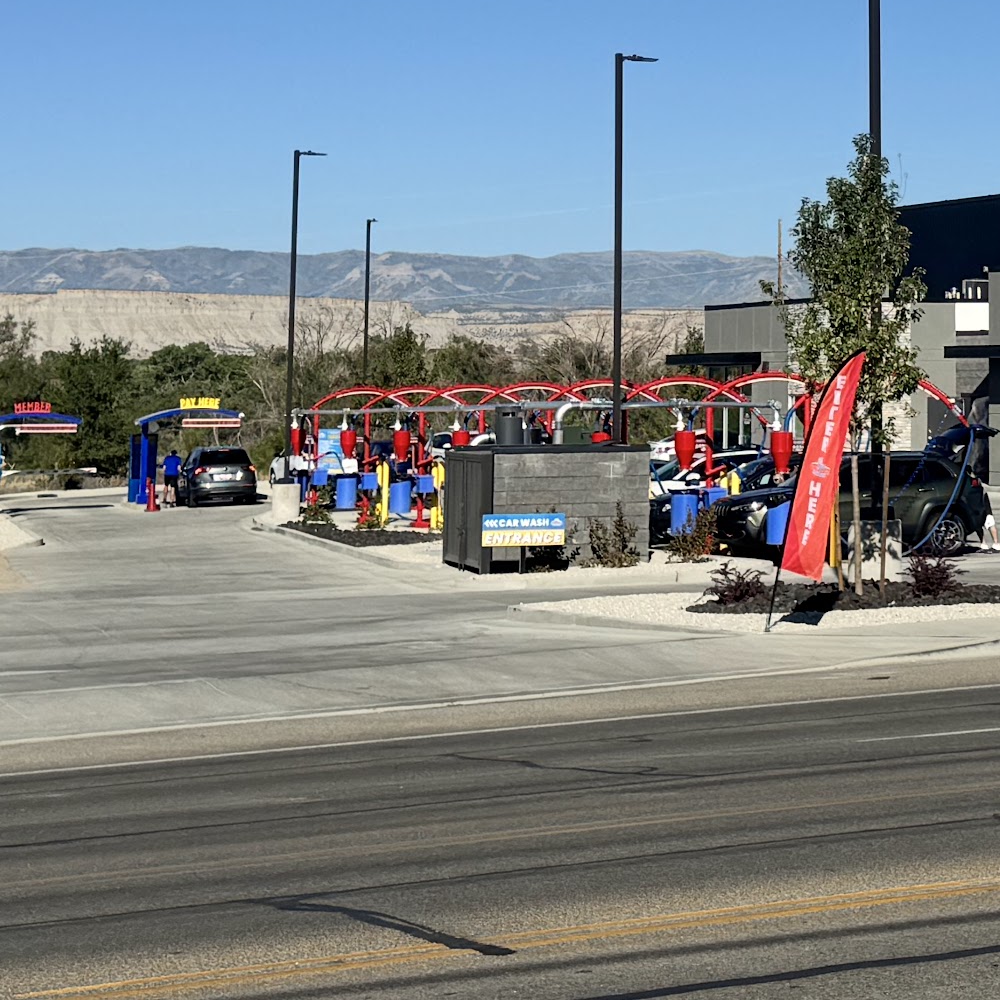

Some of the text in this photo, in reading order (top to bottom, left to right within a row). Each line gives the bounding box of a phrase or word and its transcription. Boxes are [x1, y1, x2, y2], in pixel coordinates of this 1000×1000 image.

[14, 402, 52, 414] MEMBER
[180, 397, 220, 410] PAY HERE
[801, 481, 821, 546] HERE
[498, 517, 550, 528] CAR WASH
[485, 531, 562, 545] ENTRANCE
